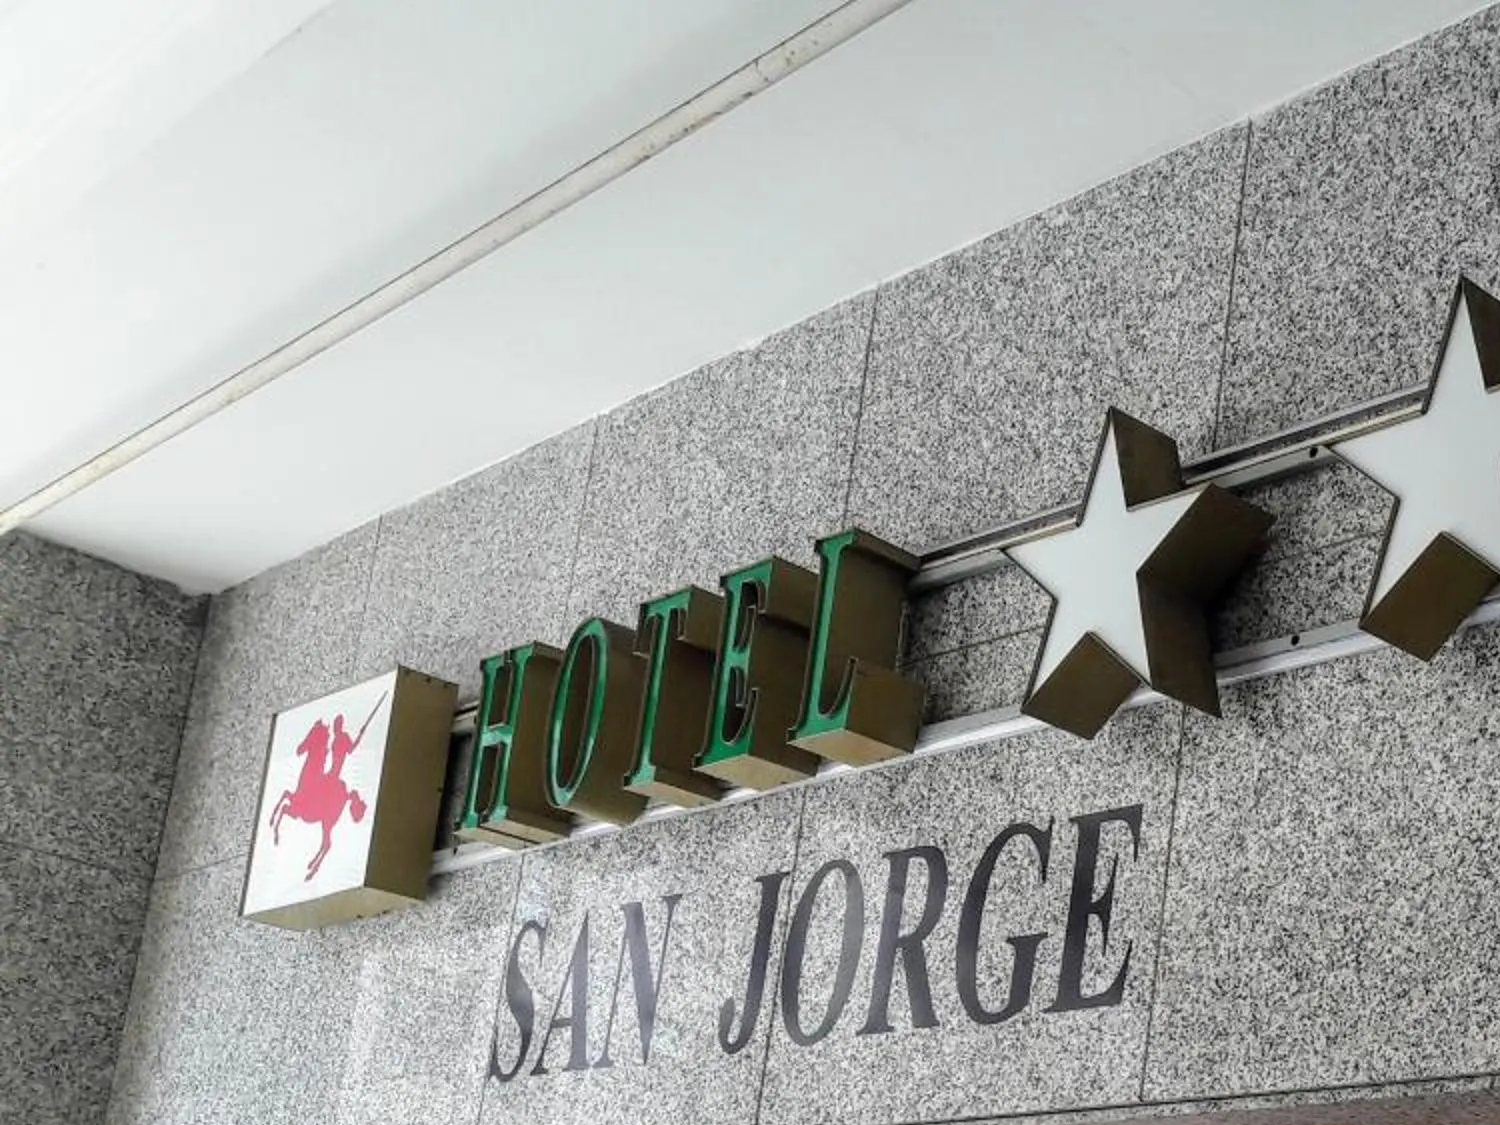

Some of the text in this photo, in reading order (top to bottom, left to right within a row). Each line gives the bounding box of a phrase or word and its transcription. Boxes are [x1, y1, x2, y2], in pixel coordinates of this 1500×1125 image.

[457, 527, 860, 832] HOTEL
[488, 803, 1145, 1083] SAN JORGE
